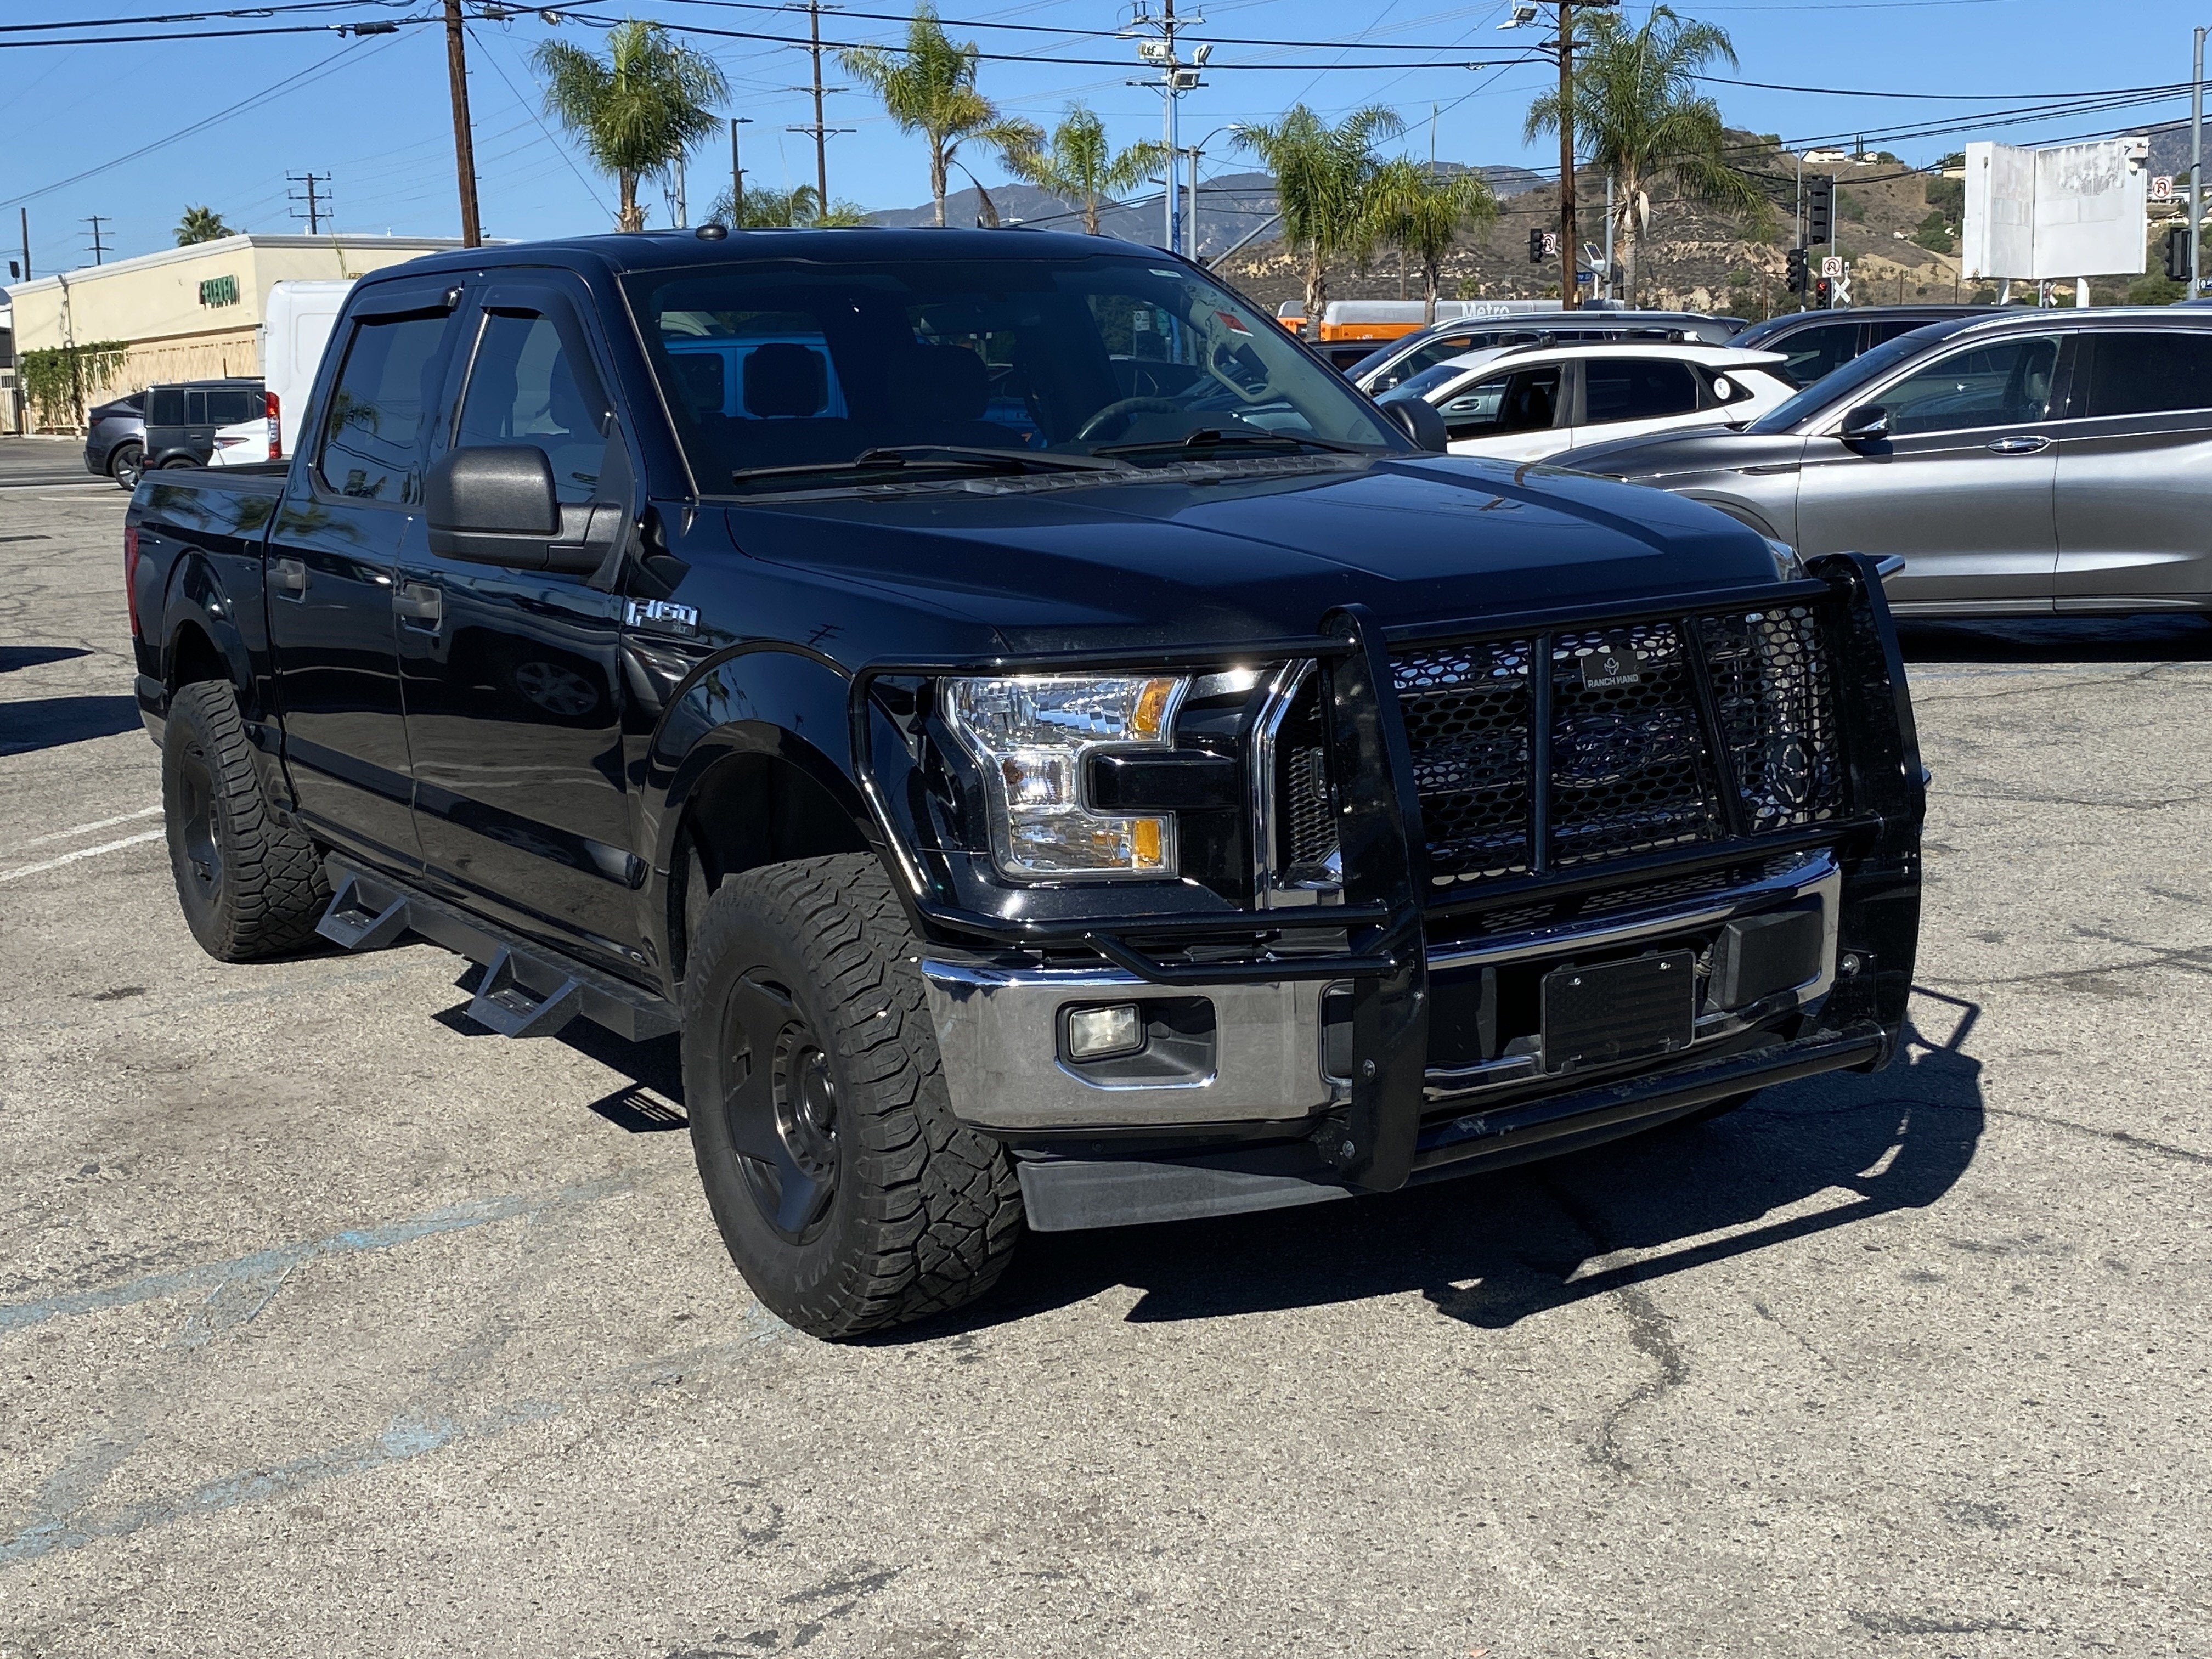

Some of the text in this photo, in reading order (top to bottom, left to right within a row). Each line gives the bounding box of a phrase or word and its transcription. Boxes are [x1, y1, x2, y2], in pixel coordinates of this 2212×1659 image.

[1461, 302, 1510, 318] Metro
[673, 624, 688, 634] XLT
[1587, 674, 1639, 688] RANCH HAND
